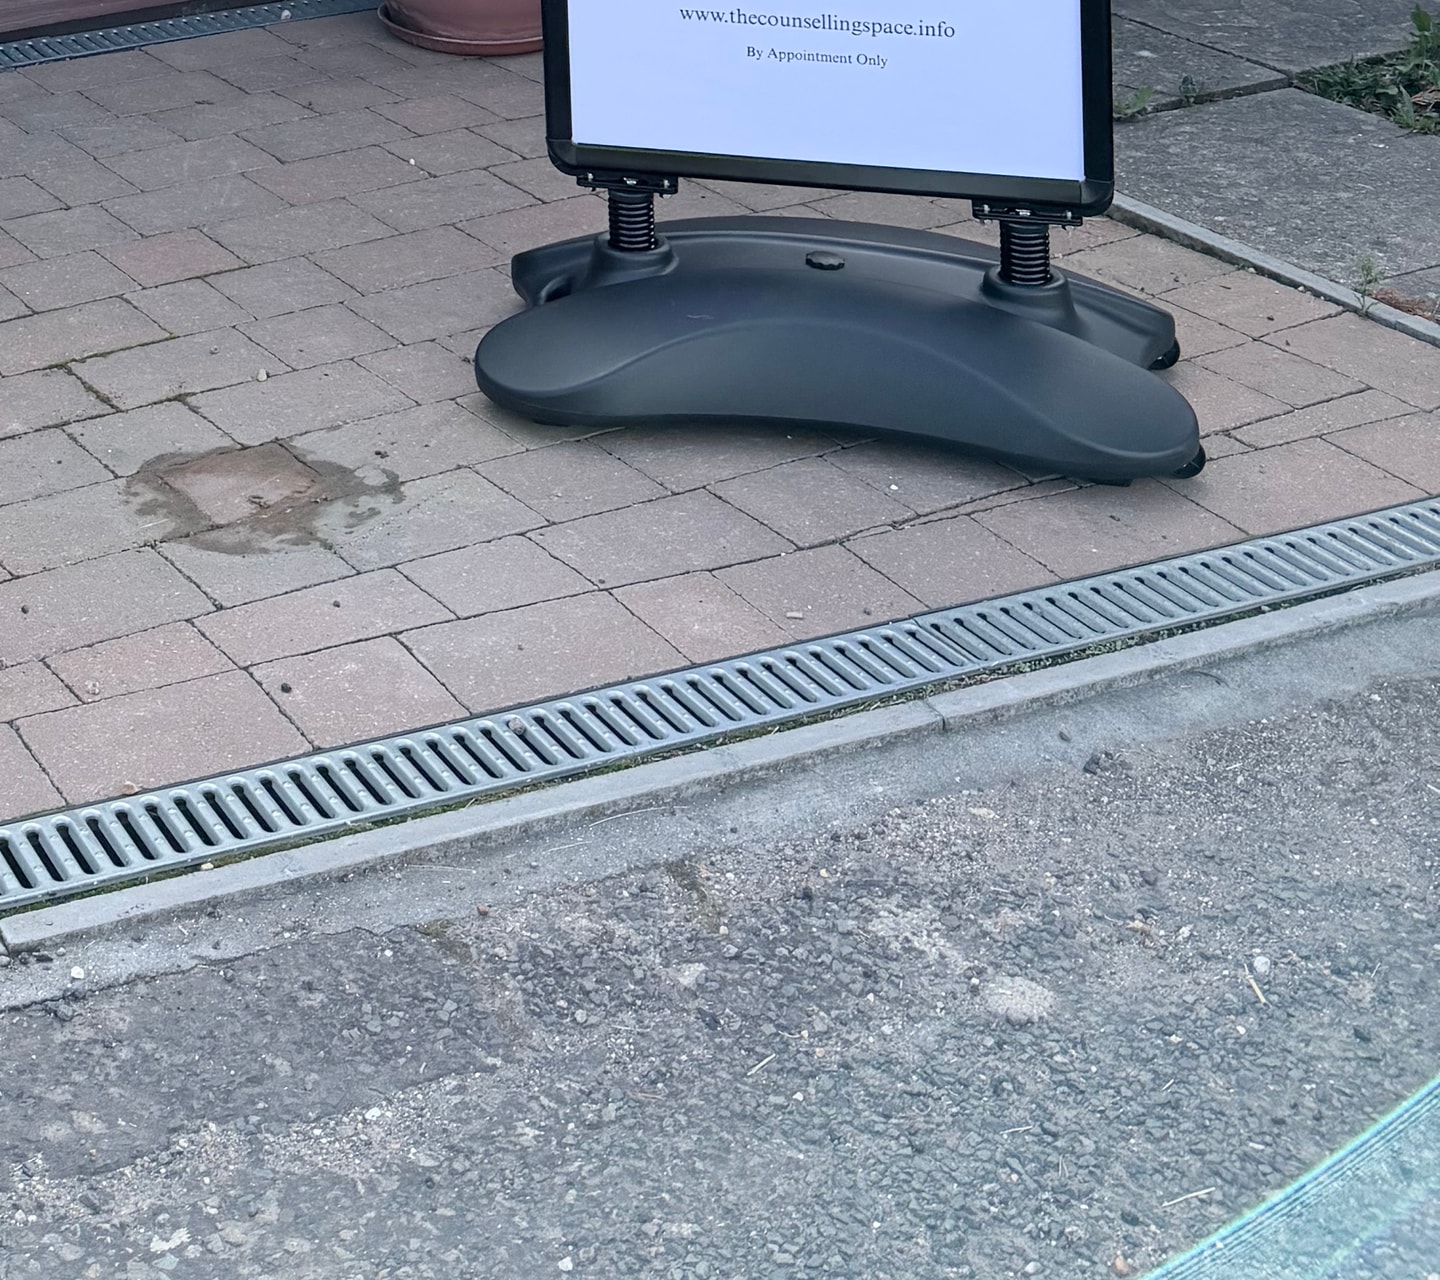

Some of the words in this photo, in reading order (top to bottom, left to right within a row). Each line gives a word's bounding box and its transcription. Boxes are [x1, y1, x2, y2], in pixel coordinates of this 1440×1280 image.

[679, 7, 956, 38] www.thecounsellingspace.info
[747, 46, 763, 60] By
[767, 48, 852, 64] Appointment
[856, 53, 888, 69] Only
